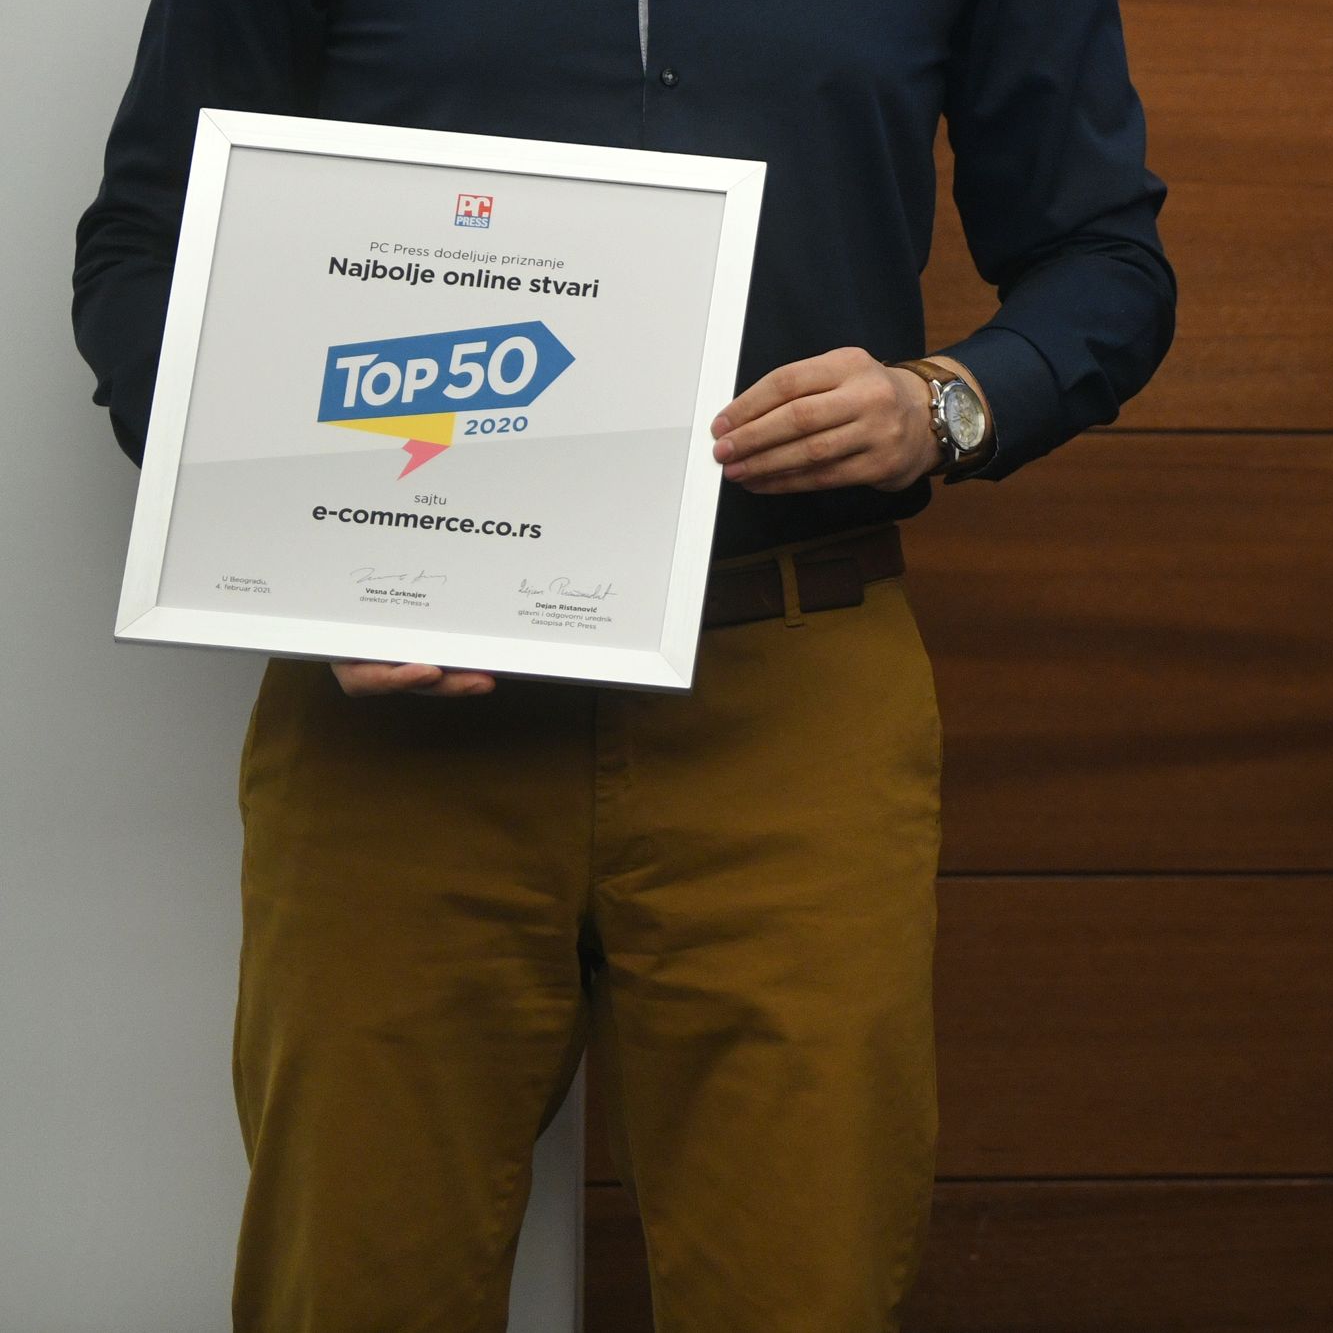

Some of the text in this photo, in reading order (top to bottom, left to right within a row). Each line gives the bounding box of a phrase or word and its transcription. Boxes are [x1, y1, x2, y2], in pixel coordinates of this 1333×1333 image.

[456, 216, 489, 228] PRESS
[369, 242, 565, 269] PC Press dodeljuje priznanje
[328, 256, 600, 298] Najbolje online stvari
[336, 336, 538, 408] TOP 50
[464, 416, 529, 436] 2020
[414, 493, 447, 506] sajtu
[312, 505, 542, 539] e-commerce.co.rs
[365, 587, 387, 595] Vesna
[359, 596, 388, 604] direktor
[535, 602, 557, 610] Dejan
